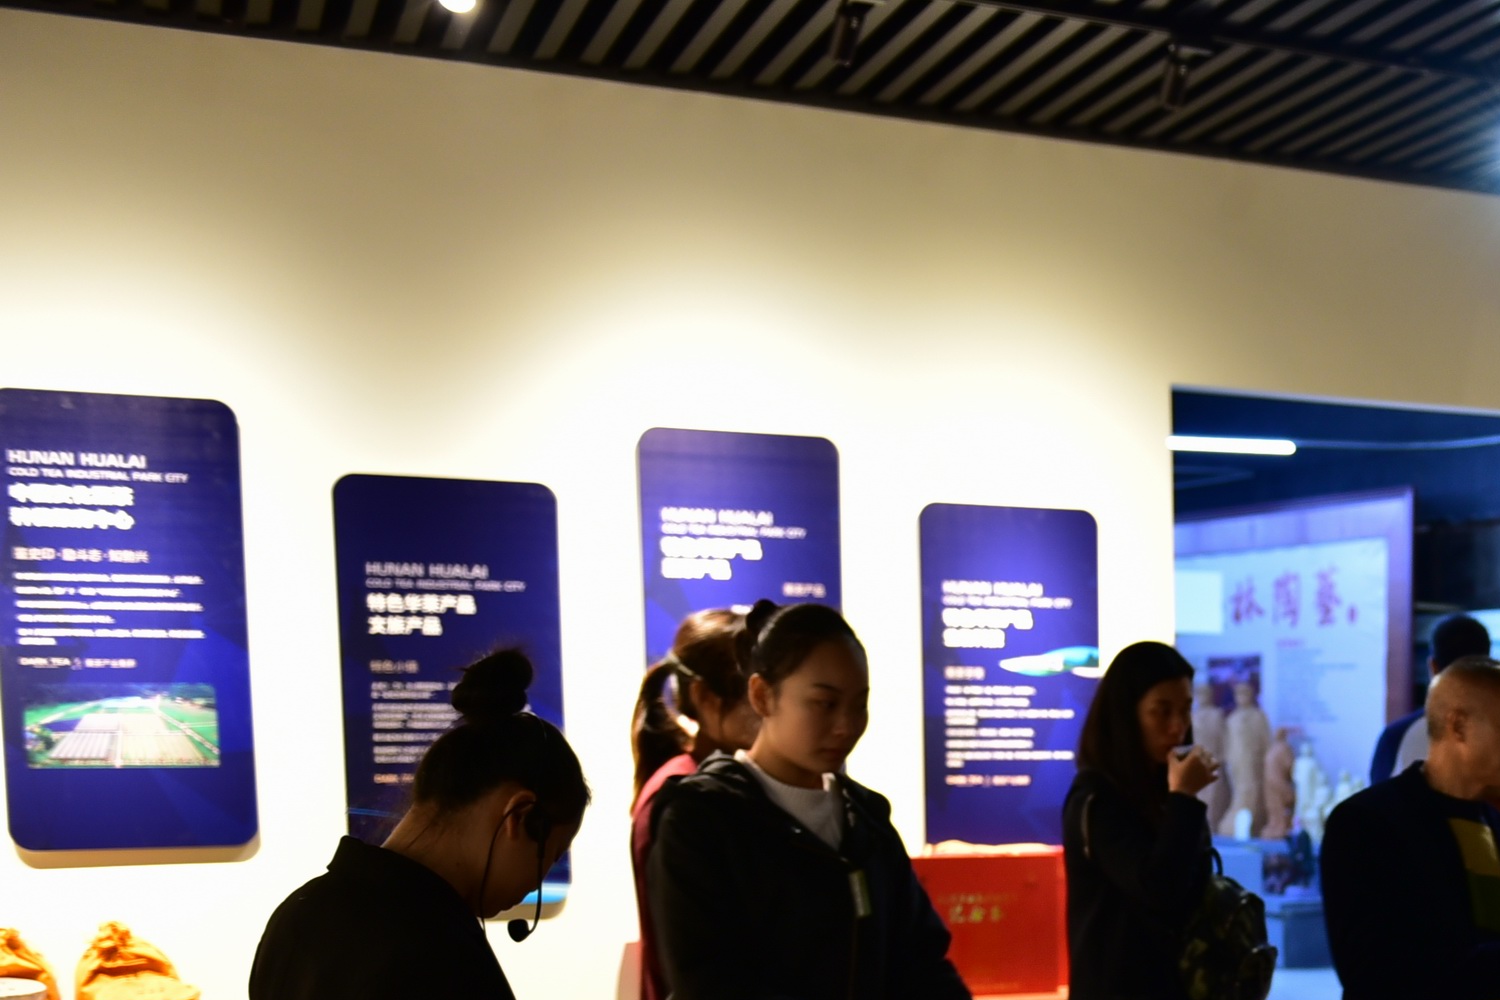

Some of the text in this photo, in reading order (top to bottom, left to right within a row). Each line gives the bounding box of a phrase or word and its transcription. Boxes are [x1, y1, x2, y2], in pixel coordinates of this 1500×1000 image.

[6, 449, 147, 469] HUNAN HUALAI
[365, 562, 425, 577] HUNAN
